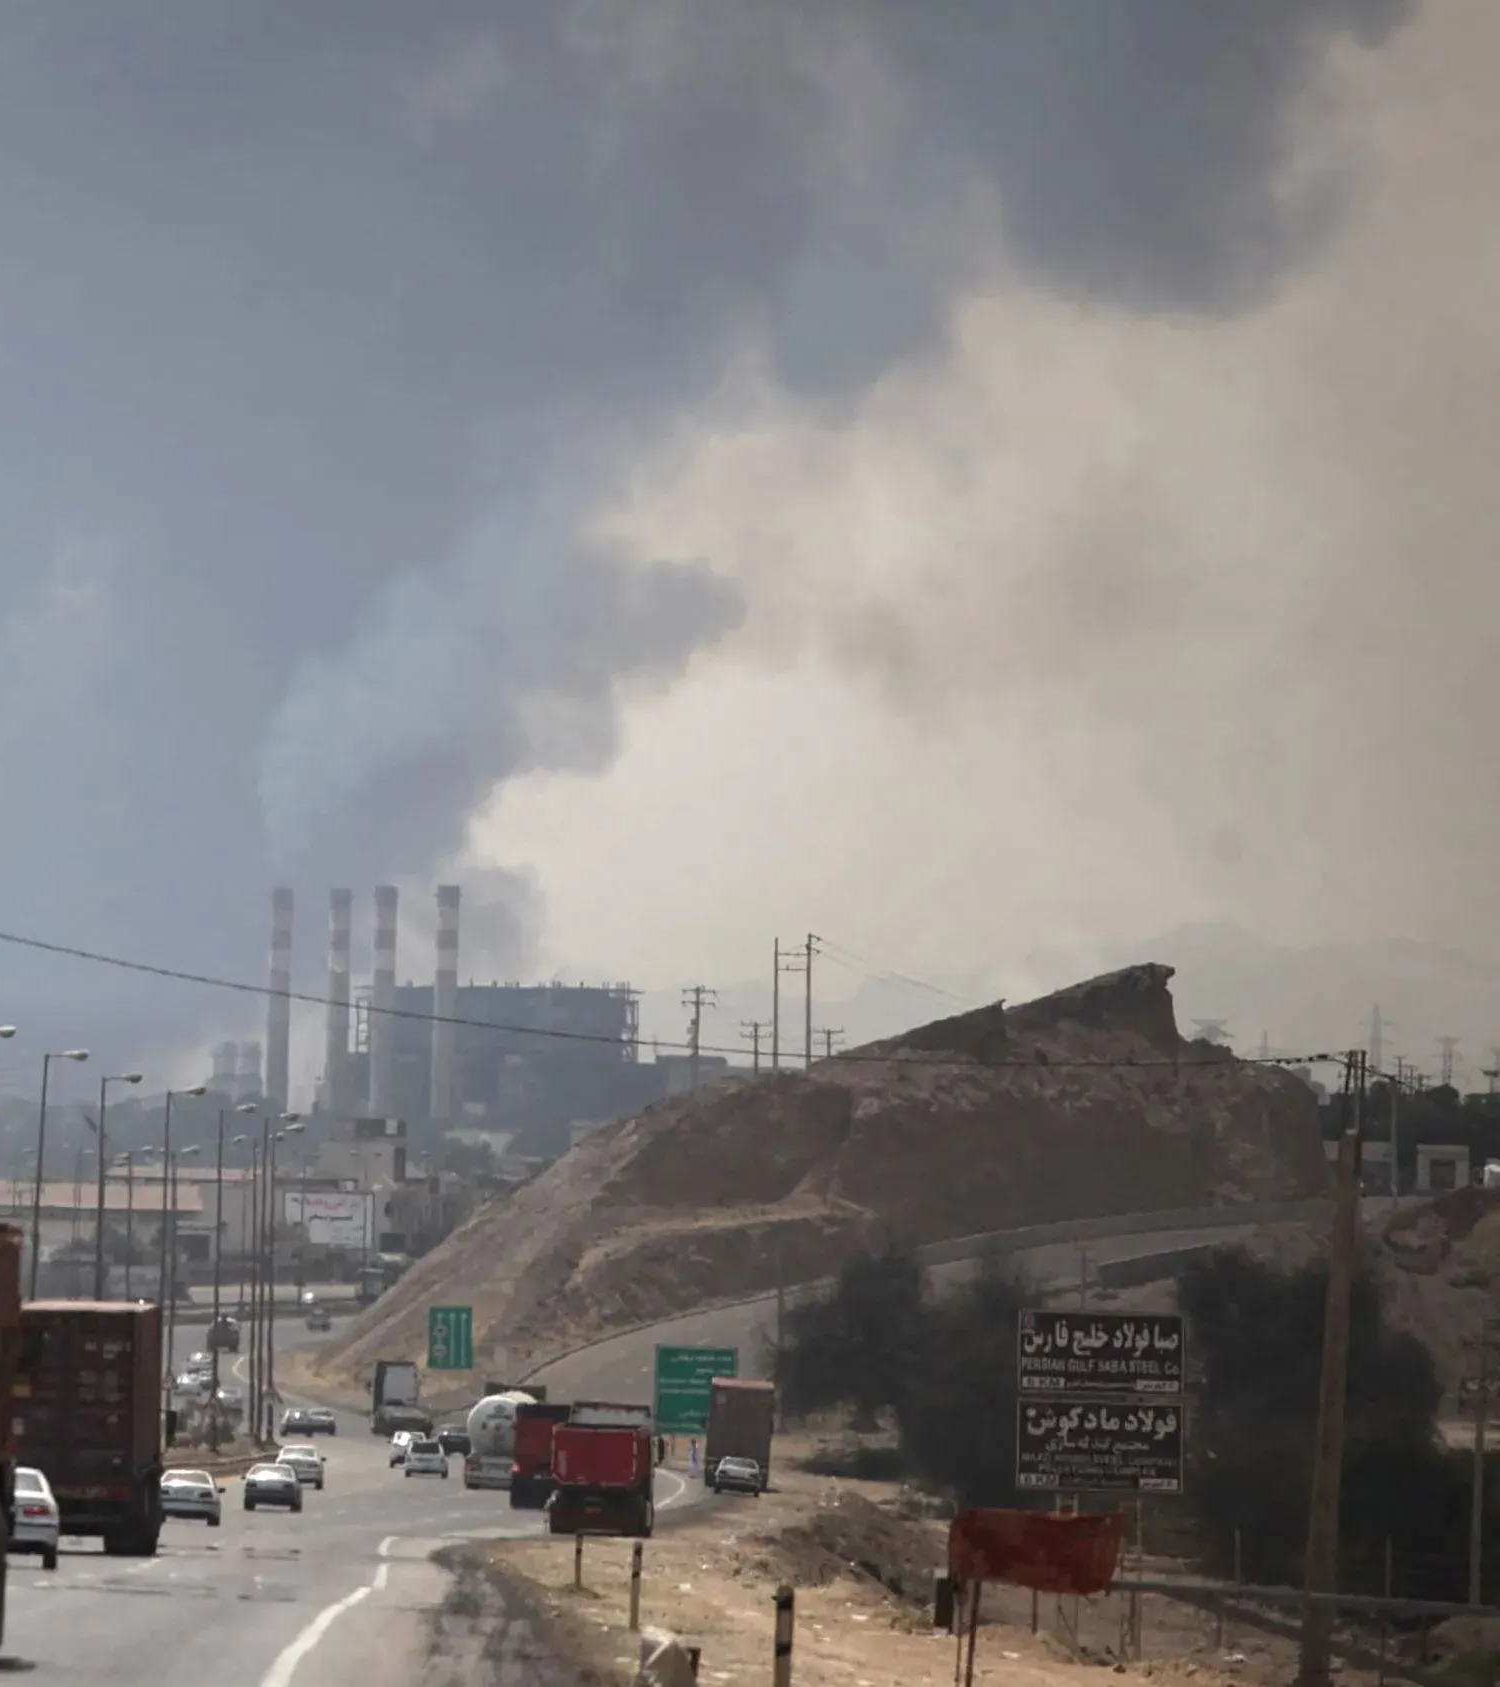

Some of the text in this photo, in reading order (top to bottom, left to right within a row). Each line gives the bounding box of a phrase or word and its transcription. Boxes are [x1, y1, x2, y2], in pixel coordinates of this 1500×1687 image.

[1022, 1319, 1069, 1353] فارس
[1112, 1321, 1150, 1358] فولاد
[1154, 1322, 1179, 1355] صبا
[1021, 1356, 1065, 1371] PERSIAN
[1067, 1358, 1096, 1373] GULF
[1098, 1359, 1127, 1374] SABA
[1128, 1360, 1161, 1375] STEEL
[1124, 1407, 1177, 1440] فولاد
